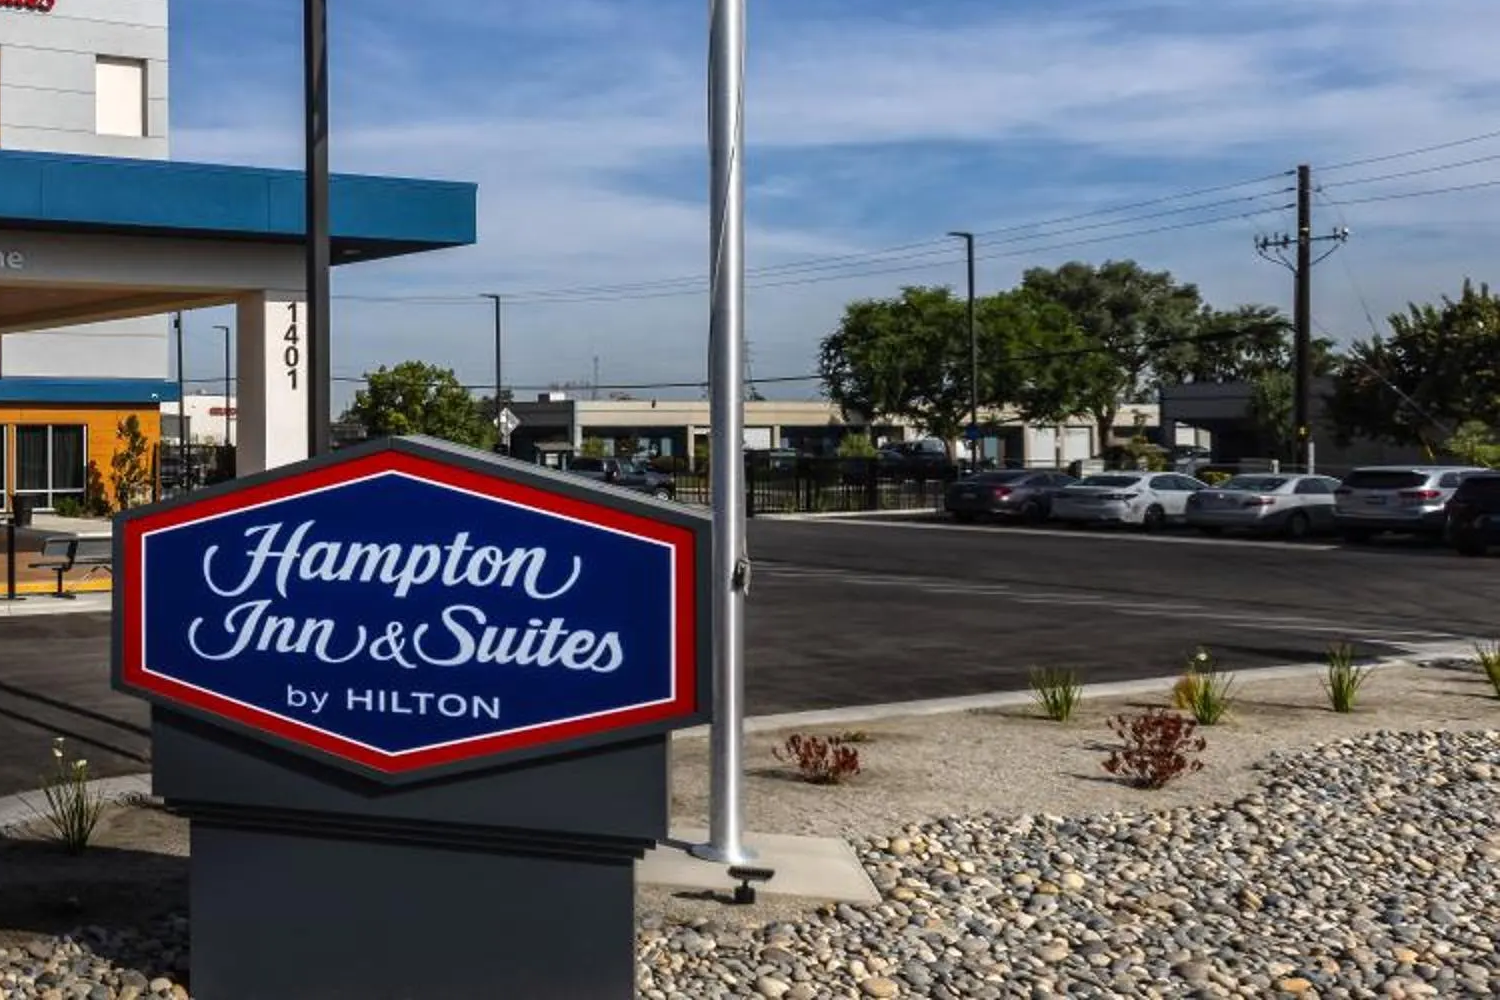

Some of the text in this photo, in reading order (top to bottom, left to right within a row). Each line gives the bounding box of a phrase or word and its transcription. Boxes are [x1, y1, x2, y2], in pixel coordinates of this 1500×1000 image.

[283, 301, 299, 390] 1401
[203, 519, 581, 600] Hampton
[188, 599, 624, 674] Inn & Suites
[286, 684, 500, 719] by HILTON
